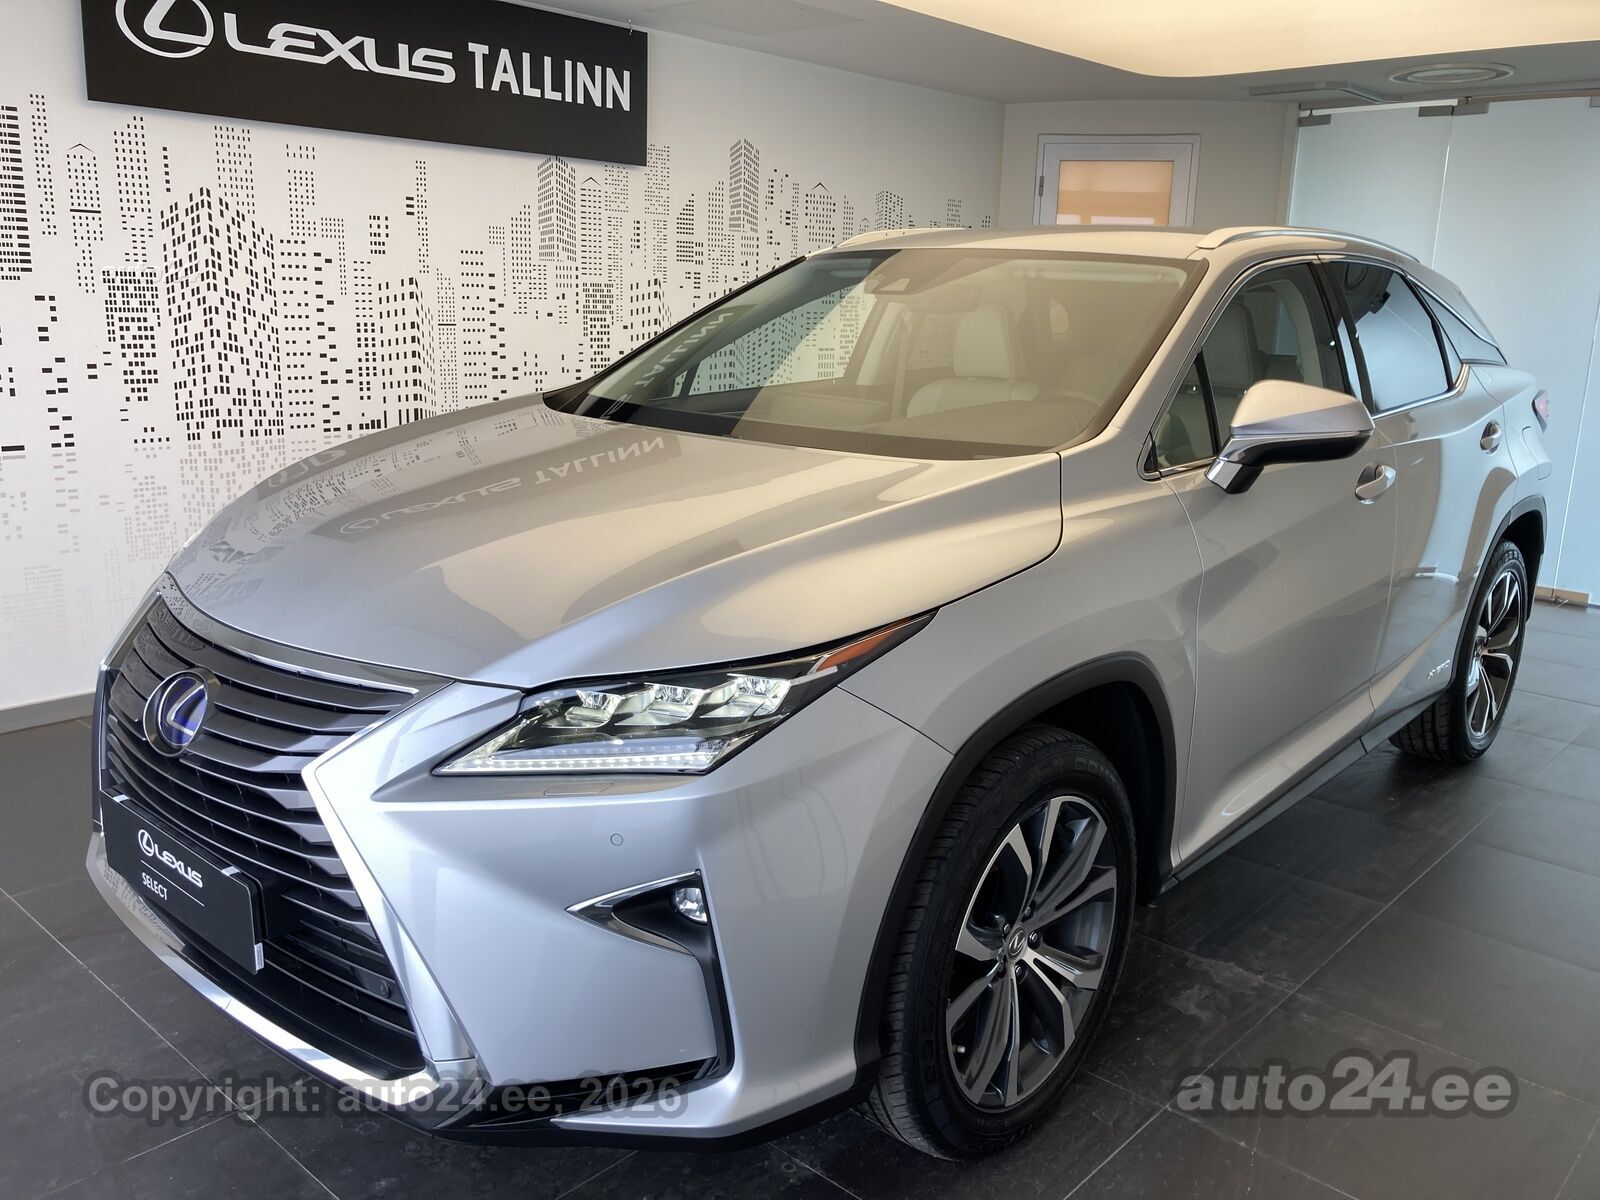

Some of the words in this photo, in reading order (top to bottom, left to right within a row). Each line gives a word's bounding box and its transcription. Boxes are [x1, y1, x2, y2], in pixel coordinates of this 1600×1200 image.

[223, 12, 456, 84] LEXUS
[468, 42, 631, 112] TALLINN
[141, 871, 168, 901] SELECT
[154, 843, 203, 888] LEXUS
